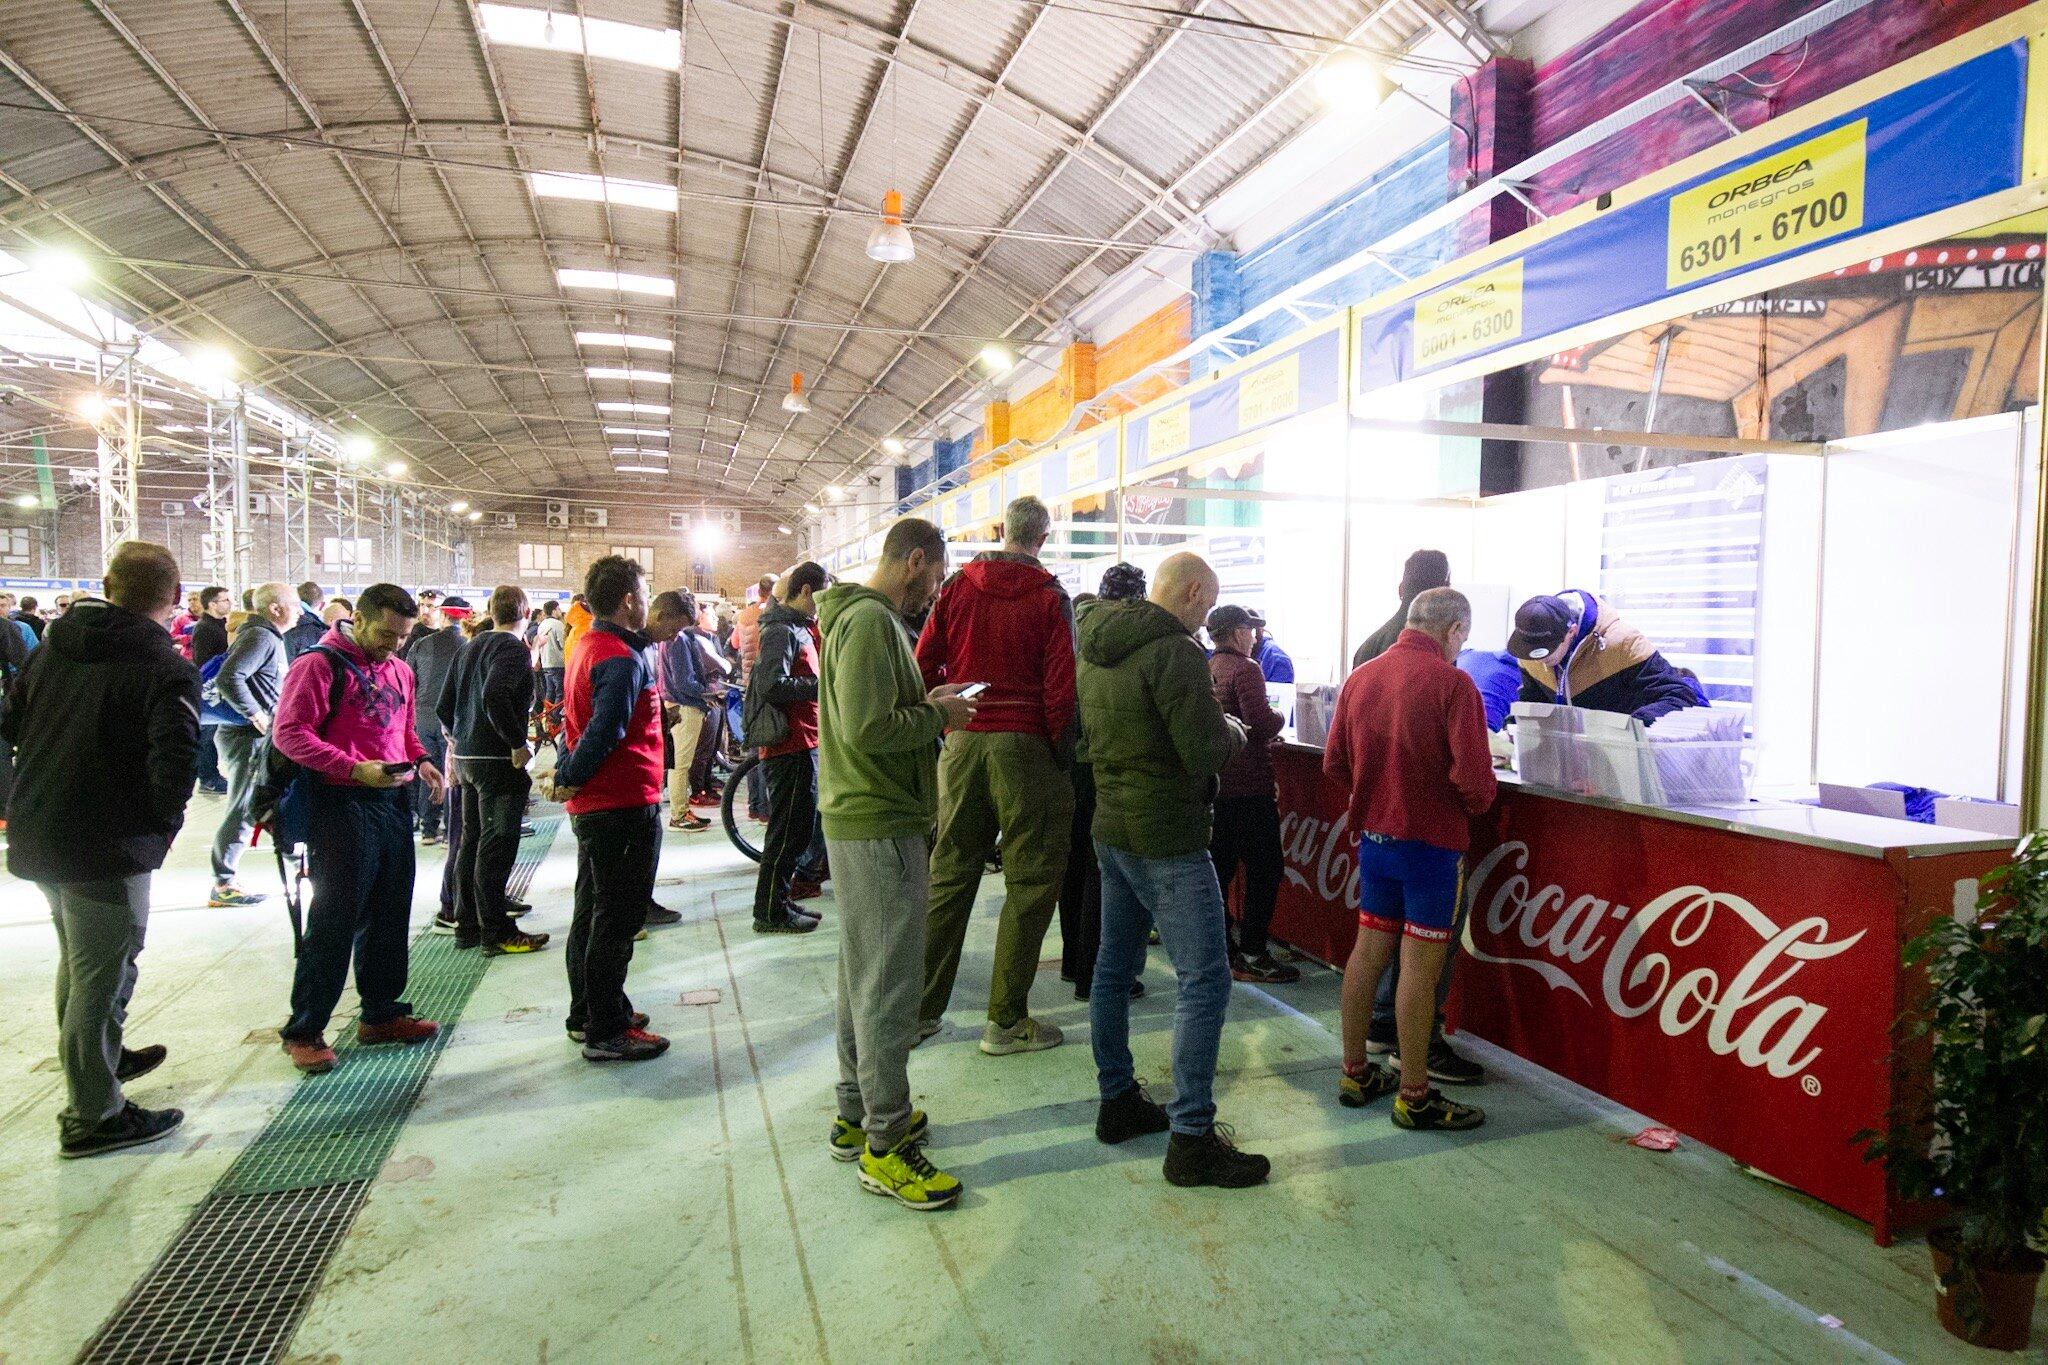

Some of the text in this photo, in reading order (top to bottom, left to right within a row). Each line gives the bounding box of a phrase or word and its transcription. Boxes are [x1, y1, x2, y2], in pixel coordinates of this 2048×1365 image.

[1707, 178, 1815, 224] monegros
[1708, 158, 1813, 210] ORBEA
[1680, 228, 1741, 272] 6301
[1772, 191, 1847, 241] 6700
[1421, 329, 1456, 358] 6001
[1472, 308, 1514, 341] 6300
[1461, 841, 1867, 1079] Coca-Cola
